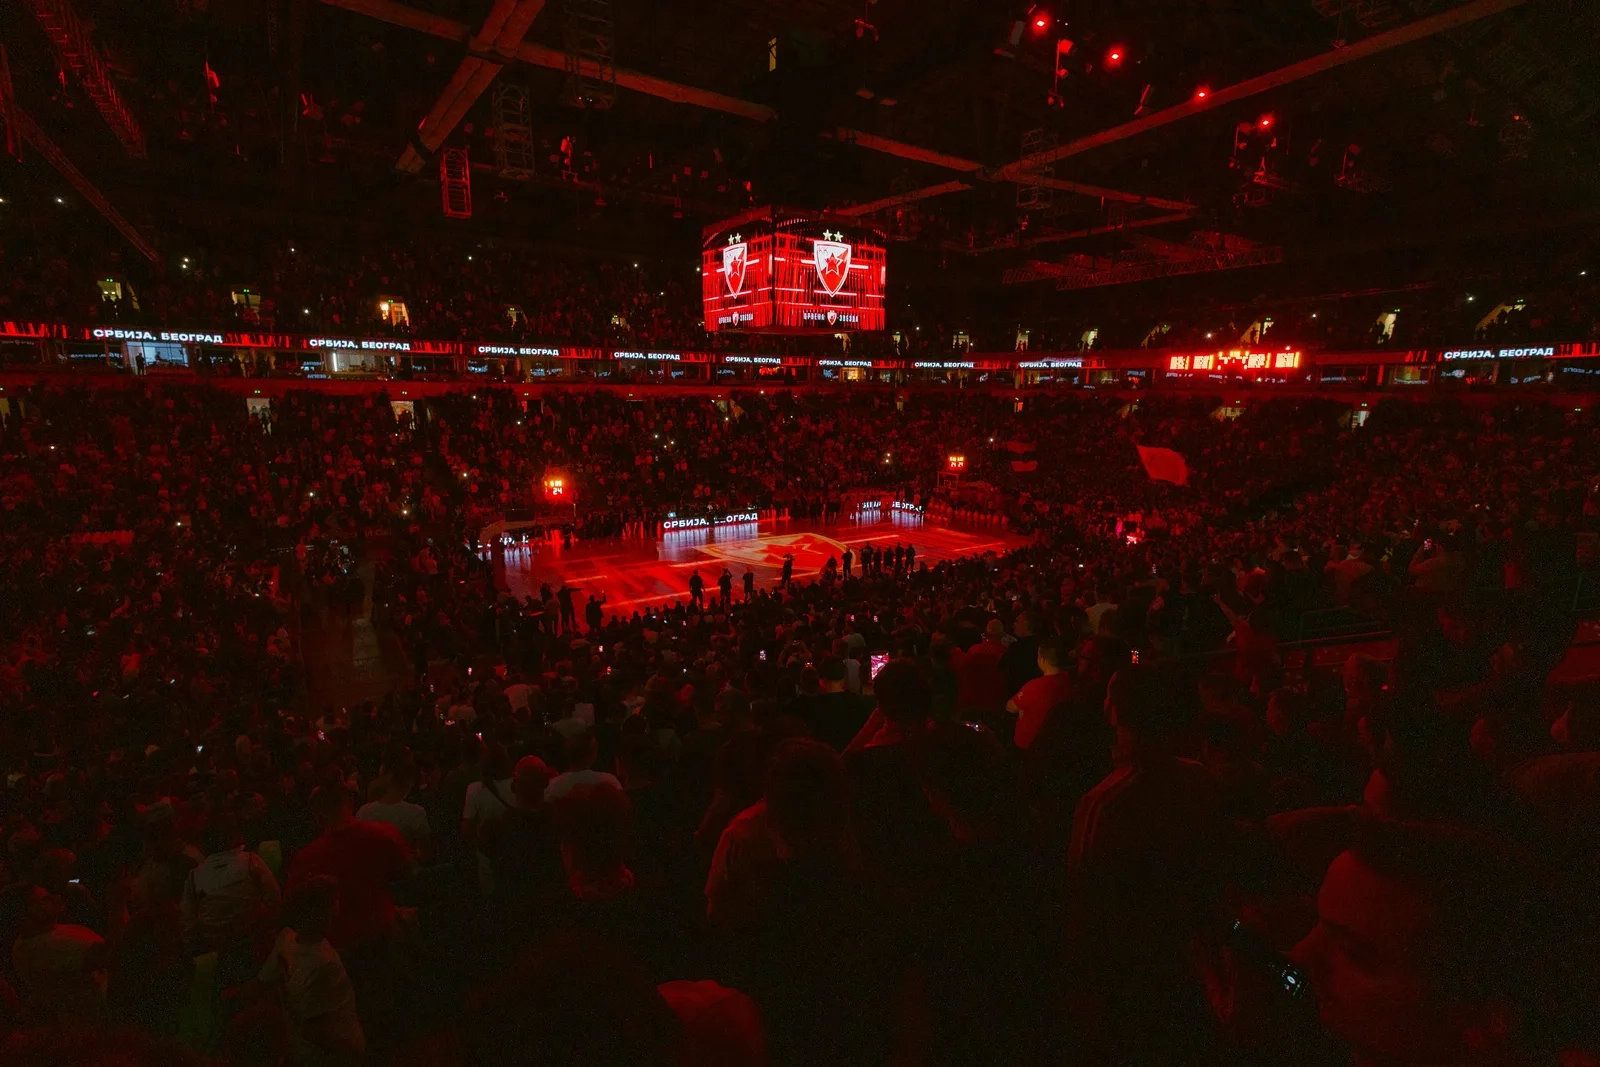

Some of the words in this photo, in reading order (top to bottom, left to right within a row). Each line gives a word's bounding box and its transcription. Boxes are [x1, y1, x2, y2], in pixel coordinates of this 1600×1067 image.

[93, 329, 157, 341] СРБИЈА,
[161, 332, 223, 344] БЕОГРАД
[309, 338, 358, 350] СРБИЈА,
[362, 341, 411, 352] БЕОГРАД
[478, 346, 518, 356] СРБИЈА,
[520, 347, 560, 357] БЕОГРАД
[613, 351, 647, 360] СРБИЈА,
[648, 353, 681, 361] БЕОГРАД
[1443, 350, 1496, 360] СРБИЈА,
[1499, 347, 1554, 358] БЕОГРАД
[754, 357, 781, 365] БЕОГРАД
[552, 487, 563, 496] 24
[663, 518, 710, 529] СРБИЈА,
[714, 512, 758, 525] ОГРАД
